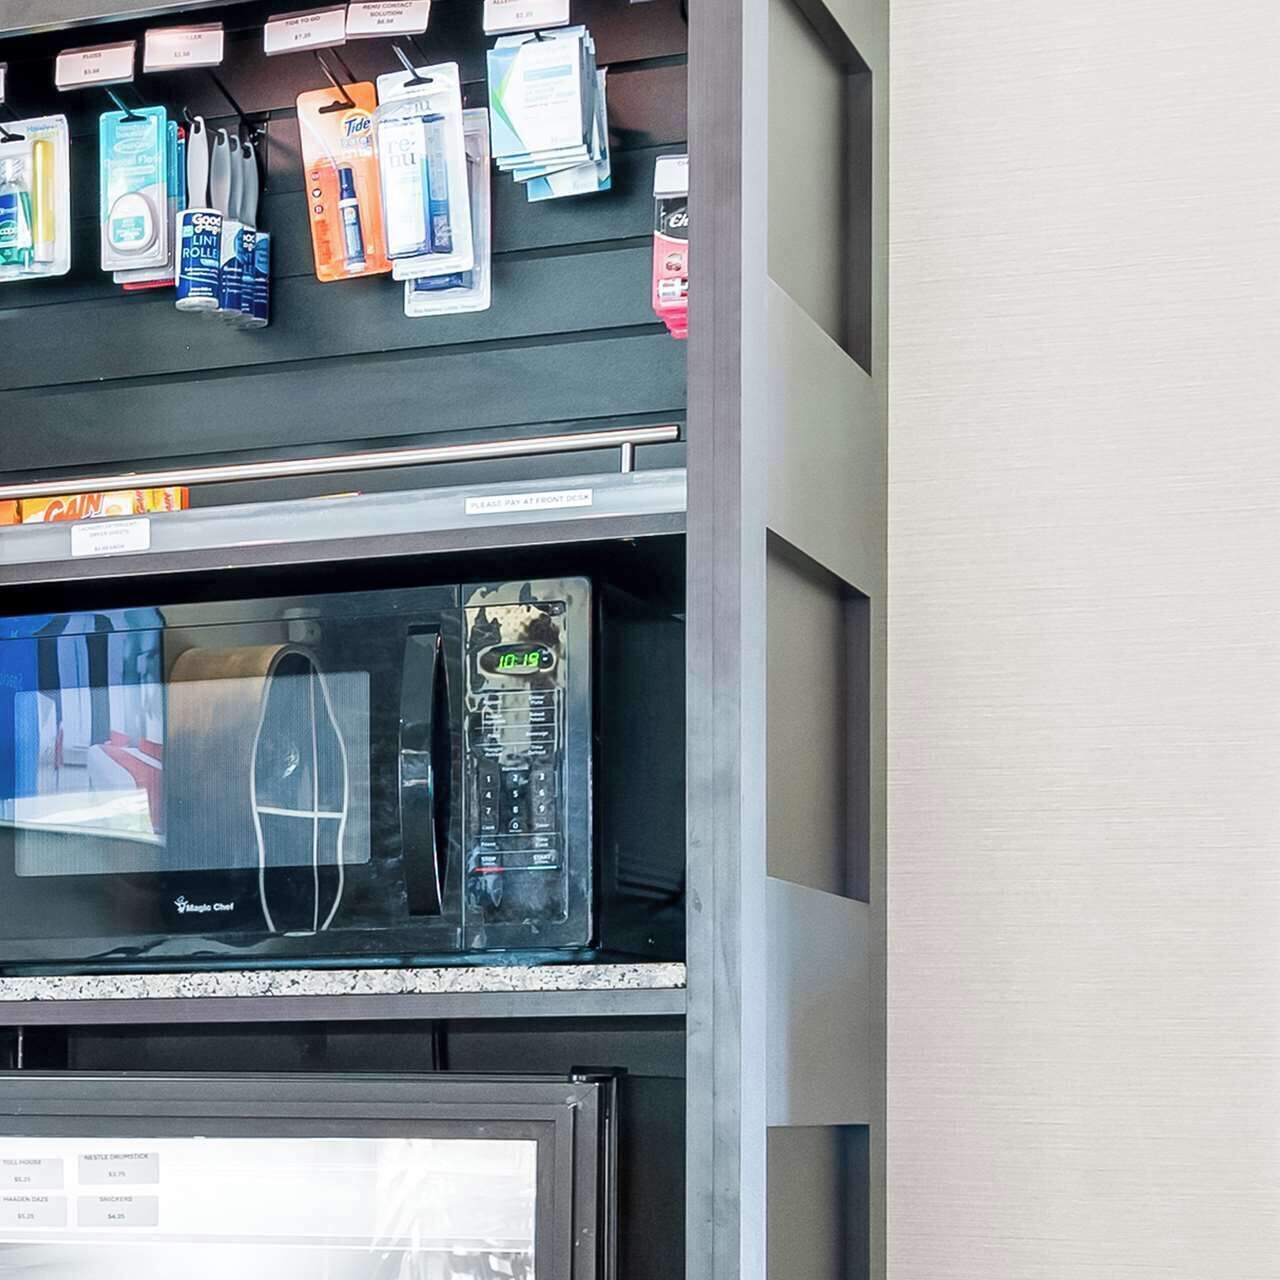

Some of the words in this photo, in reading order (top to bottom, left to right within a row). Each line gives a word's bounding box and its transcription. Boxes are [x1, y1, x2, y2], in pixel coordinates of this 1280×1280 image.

[344, 117, 371, 137] Tide
[191, 213, 222, 227] Good
[192, 233, 218, 247] LINT
[181, 246, 220, 261] ROLLE
[470, 499, 502, 508] PLEASE
[505, 498, 521, 507] PAY
[535, 495, 564, 504] FRONT
[566, 493, 589, 502] DESK
[498, 651, 541, 669] 10:19
[486, 775, 491, 783] 1
[539, 773, 545, 781] 3
[485, 791, 491, 799] 4
[512, 790, 518, 798] 5
[485, 807, 491, 815] 7
[539, 805, 545, 813] 9
[512, 822, 519, 830] 0
[533, 853, 551, 862] START
[186, 904, 212, 913] Magic
[213, 902, 235, 911] Chef
